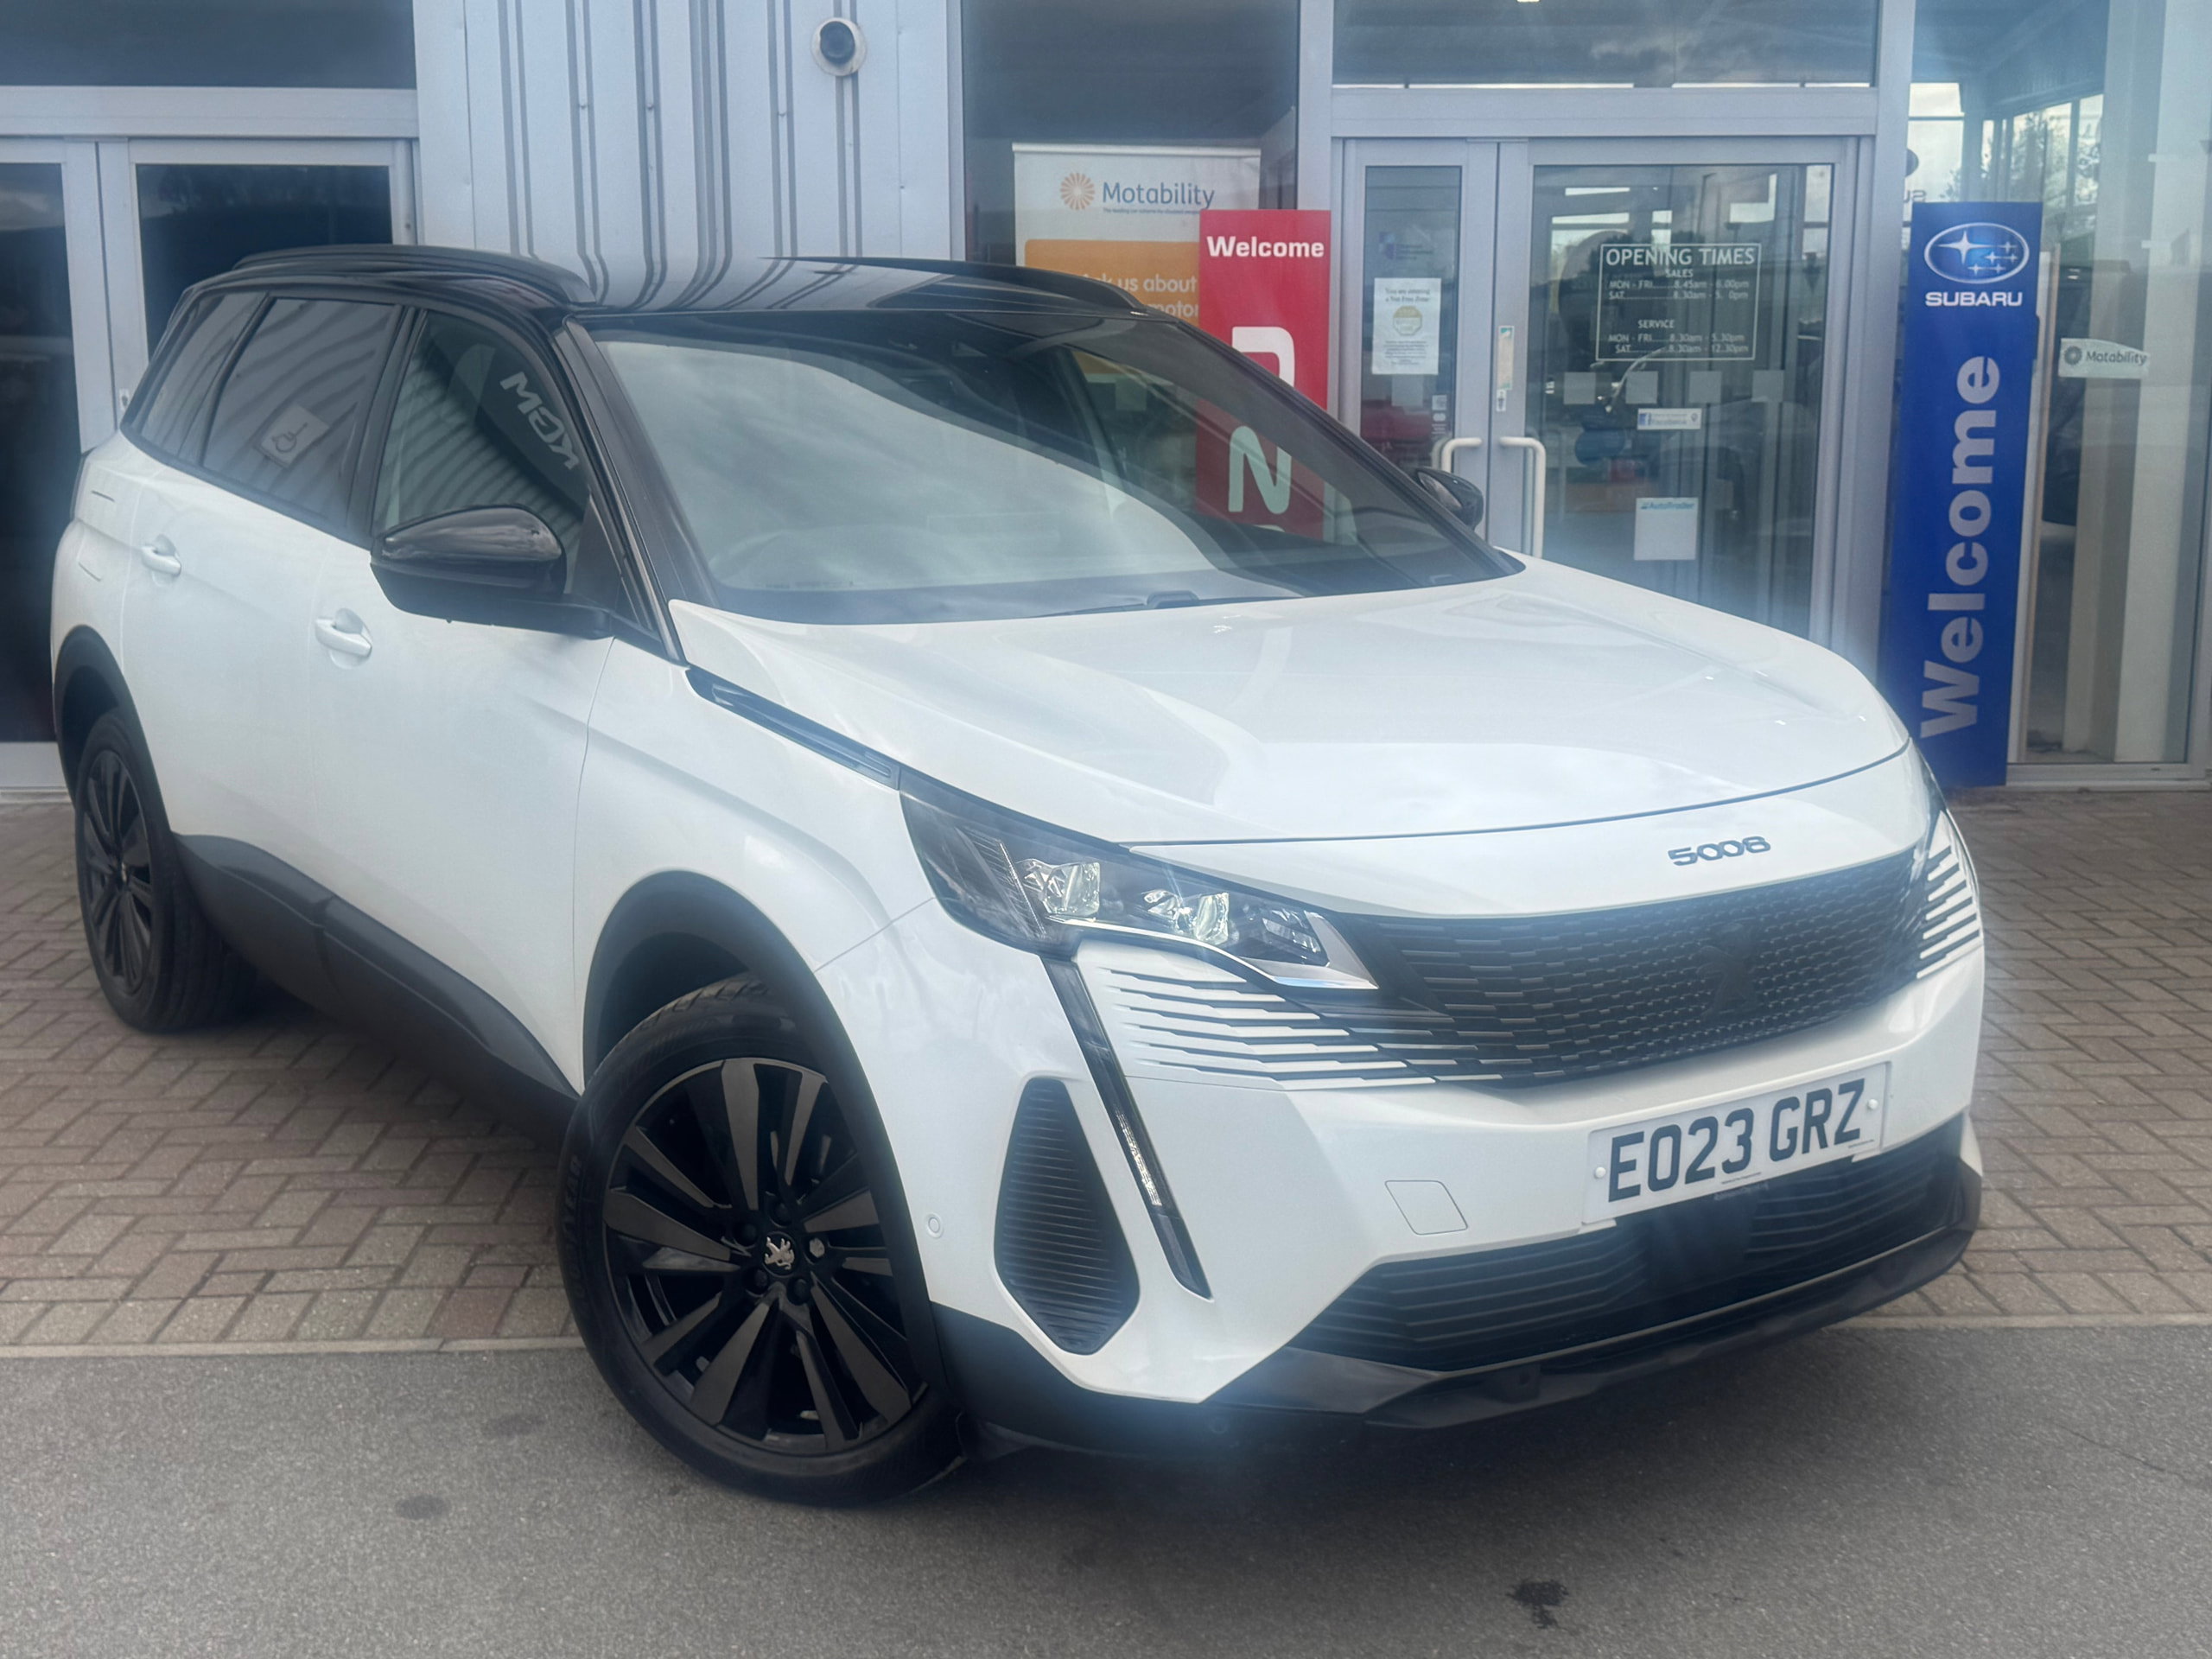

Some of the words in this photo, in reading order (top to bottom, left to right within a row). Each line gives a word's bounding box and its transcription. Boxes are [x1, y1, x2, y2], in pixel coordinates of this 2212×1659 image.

[1103, 181, 1215, 210] Motability
[1206, 235, 1325, 258] Welcome
[1606, 248, 1693, 266] OPENING
[1699, 248, 1756, 265] TIMES
[1117, 277, 1139, 292] us
[1142, 273, 1198, 293] about
[1664, 269, 1694, 278] SALES
[1924, 290, 2023, 307] SUBARU
[1637, 319, 1675, 328] SERVICE
[2086, 350, 2148, 367] Motability
[1919, 355, 2000, 739] Welcome
[1668, 835, 1771, 867] 5008
[1608, 1107, 1755, 1204] EO23
[1768, 1077, 1866, 1162] GRZ
